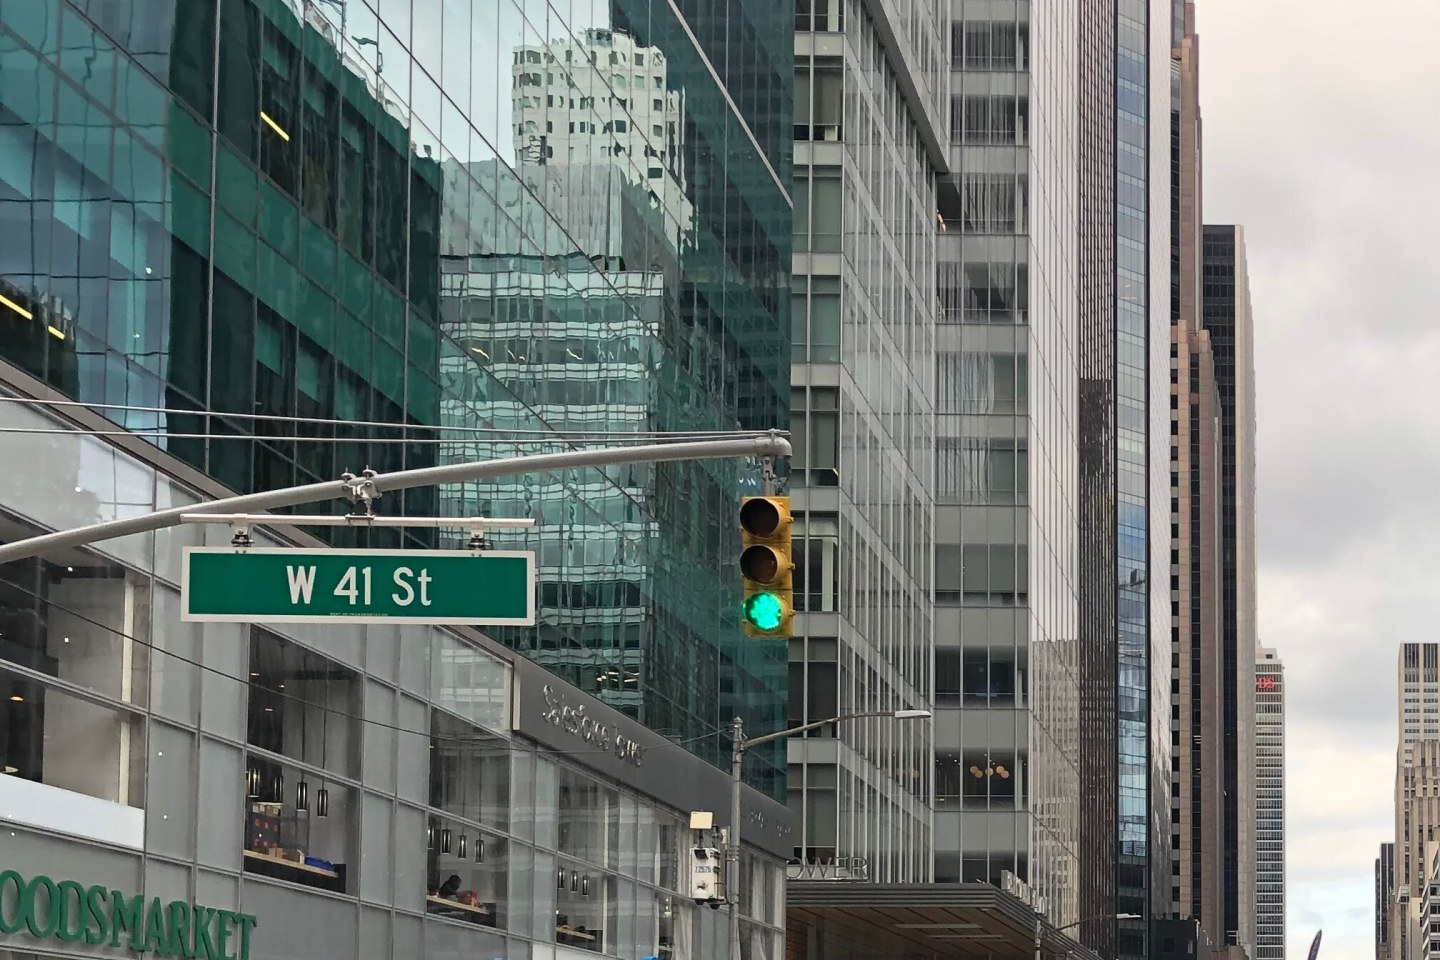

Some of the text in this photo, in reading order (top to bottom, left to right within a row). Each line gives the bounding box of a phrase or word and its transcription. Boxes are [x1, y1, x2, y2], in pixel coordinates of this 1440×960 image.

[286, 566, 432, 606] W 41 St
